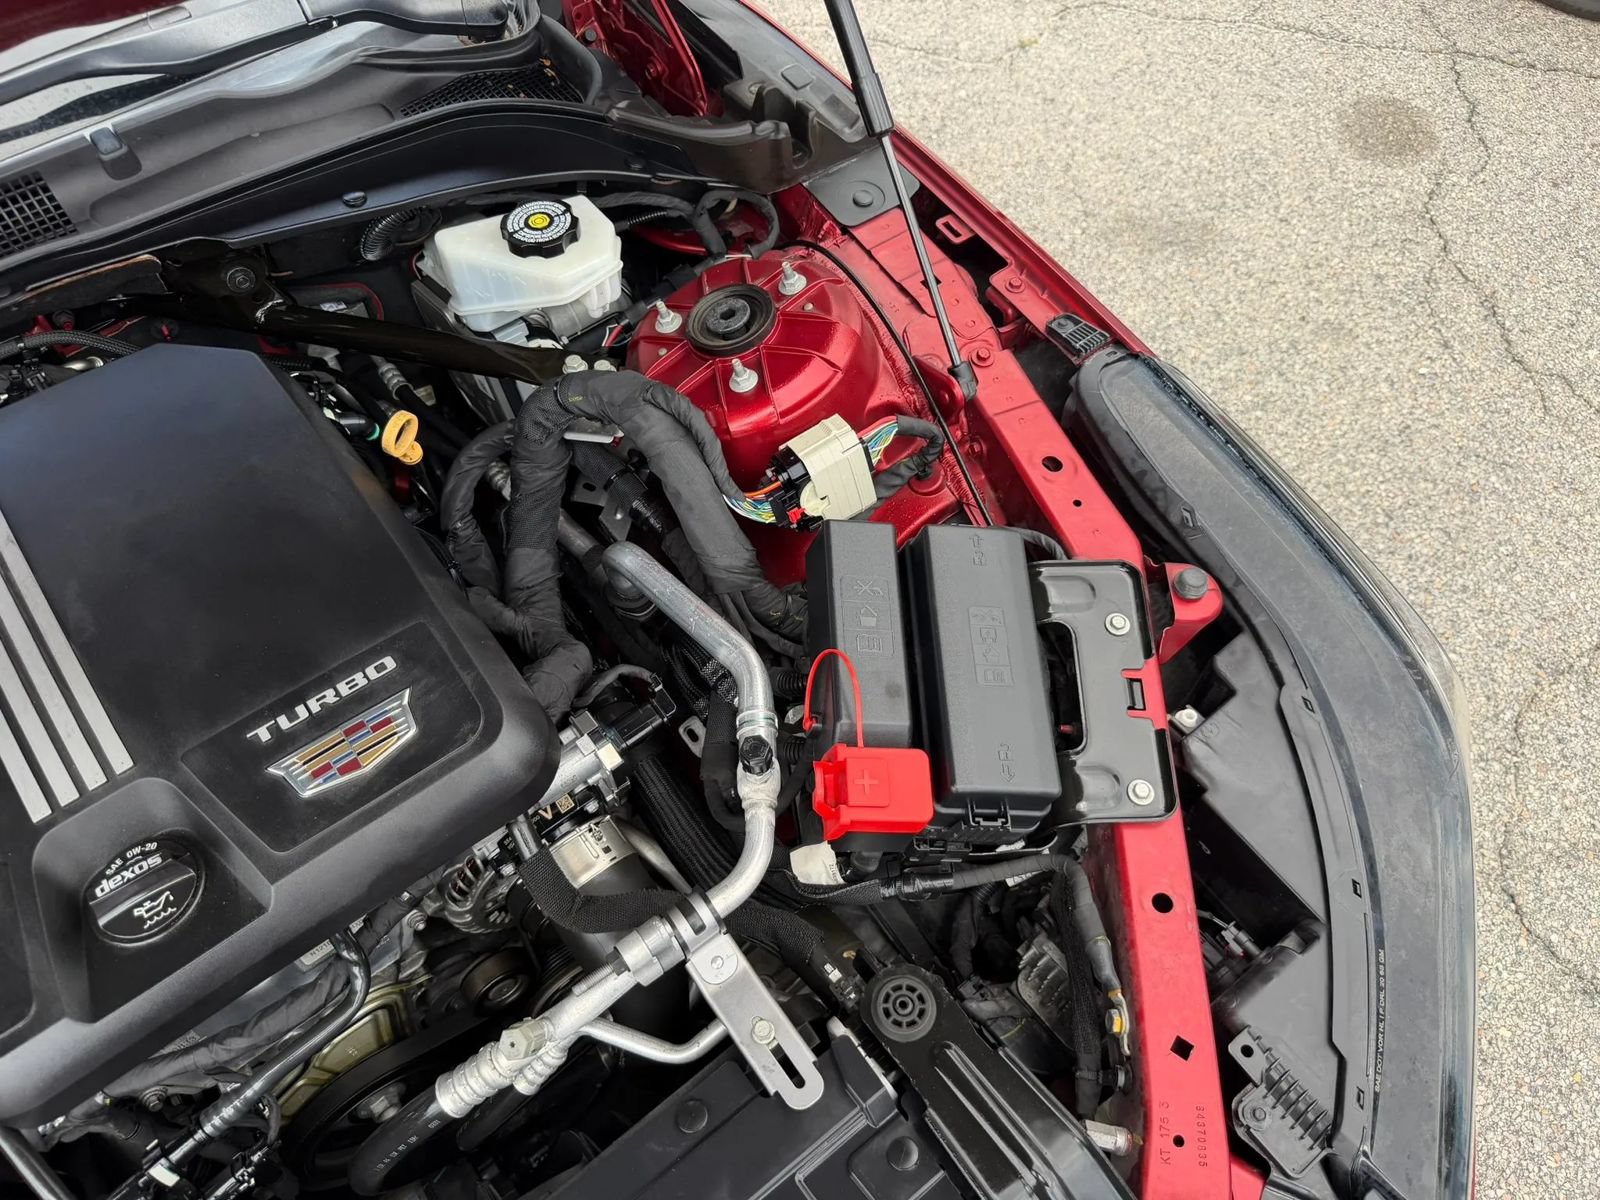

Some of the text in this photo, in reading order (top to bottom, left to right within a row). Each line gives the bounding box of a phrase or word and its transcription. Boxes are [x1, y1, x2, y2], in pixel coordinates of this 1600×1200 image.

[246, 655, 397, 742] TURBO
[95, 855, 163, 897] dexos
[105, 842, 158, 875] SAE 0W-20
[1160, 1148, 1171, 1166] KT
